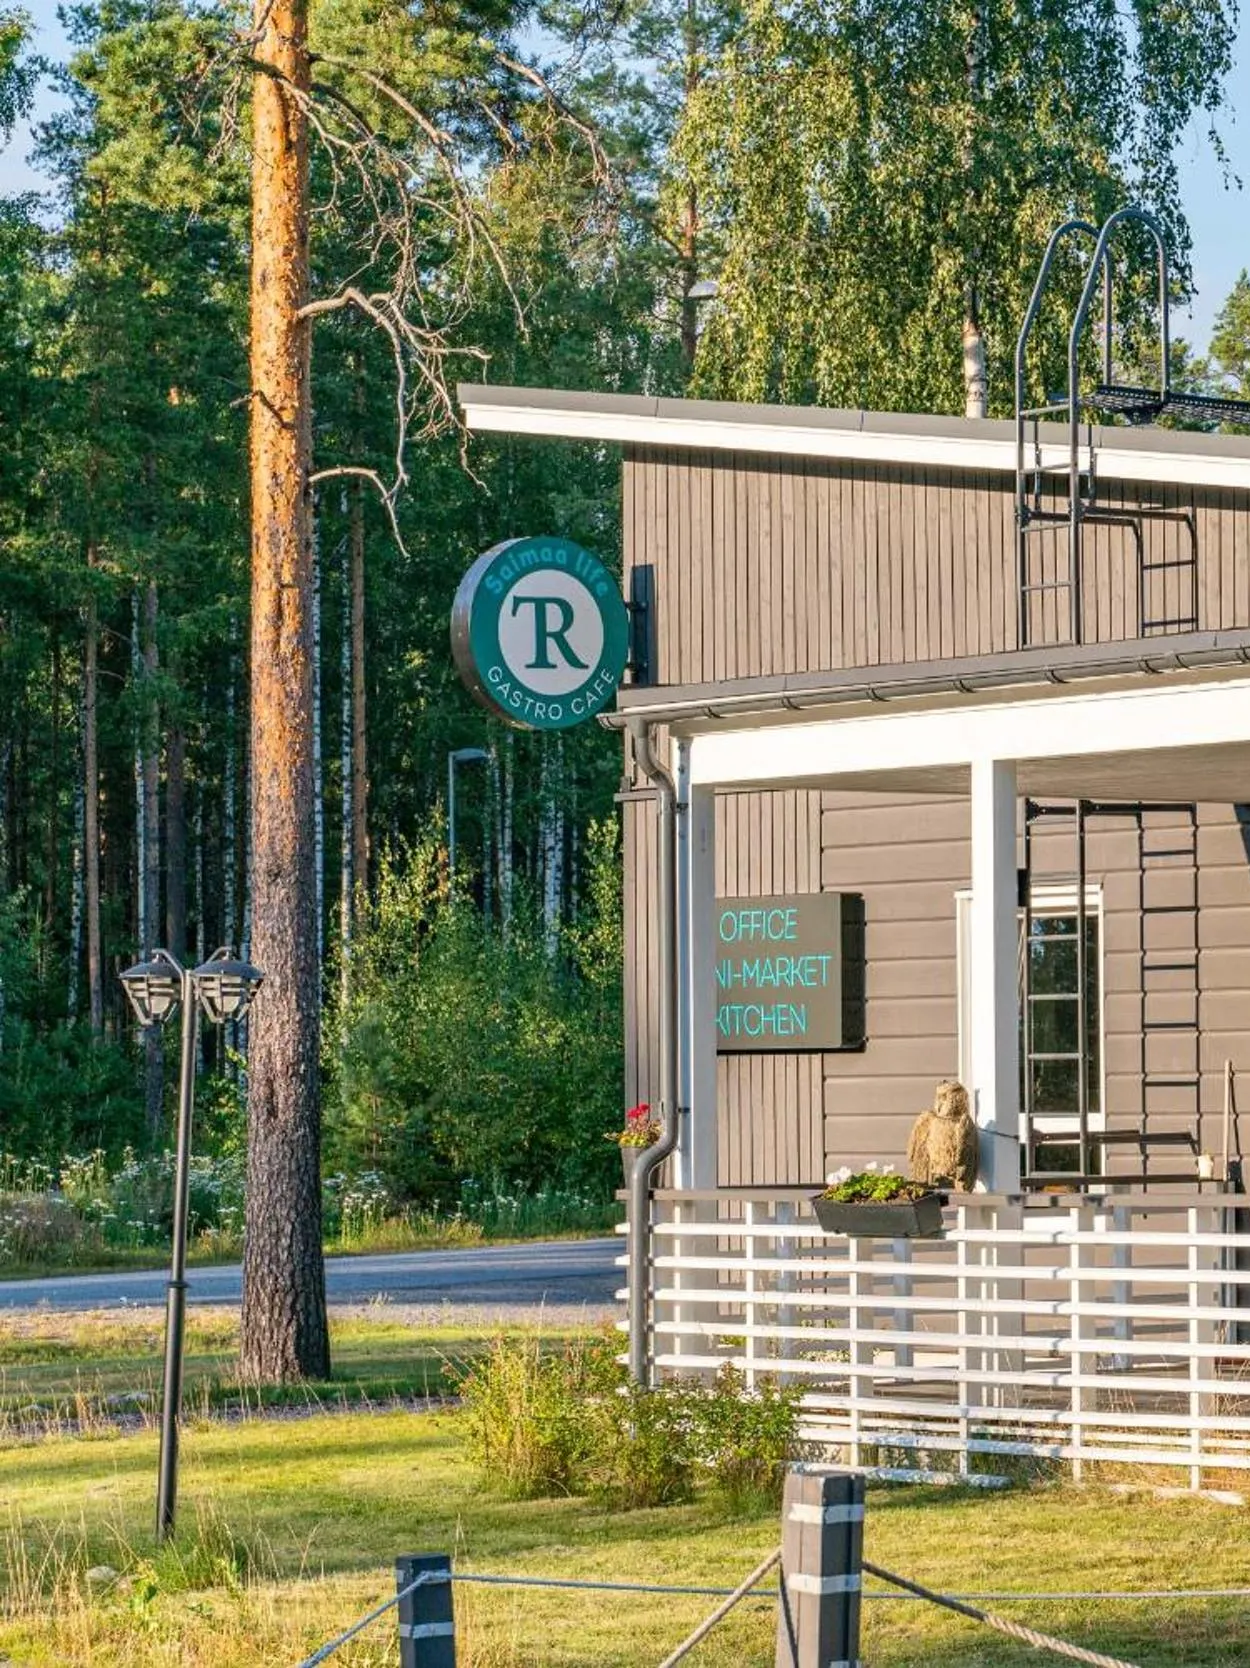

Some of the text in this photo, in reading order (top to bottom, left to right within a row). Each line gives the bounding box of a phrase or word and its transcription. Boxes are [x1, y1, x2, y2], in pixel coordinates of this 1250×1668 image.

[485, 547, 610, 597] Saimaa life
[487, 665, 615, 721] GASTRO CAFE
[719, 907, 799, 942] OFFICE
